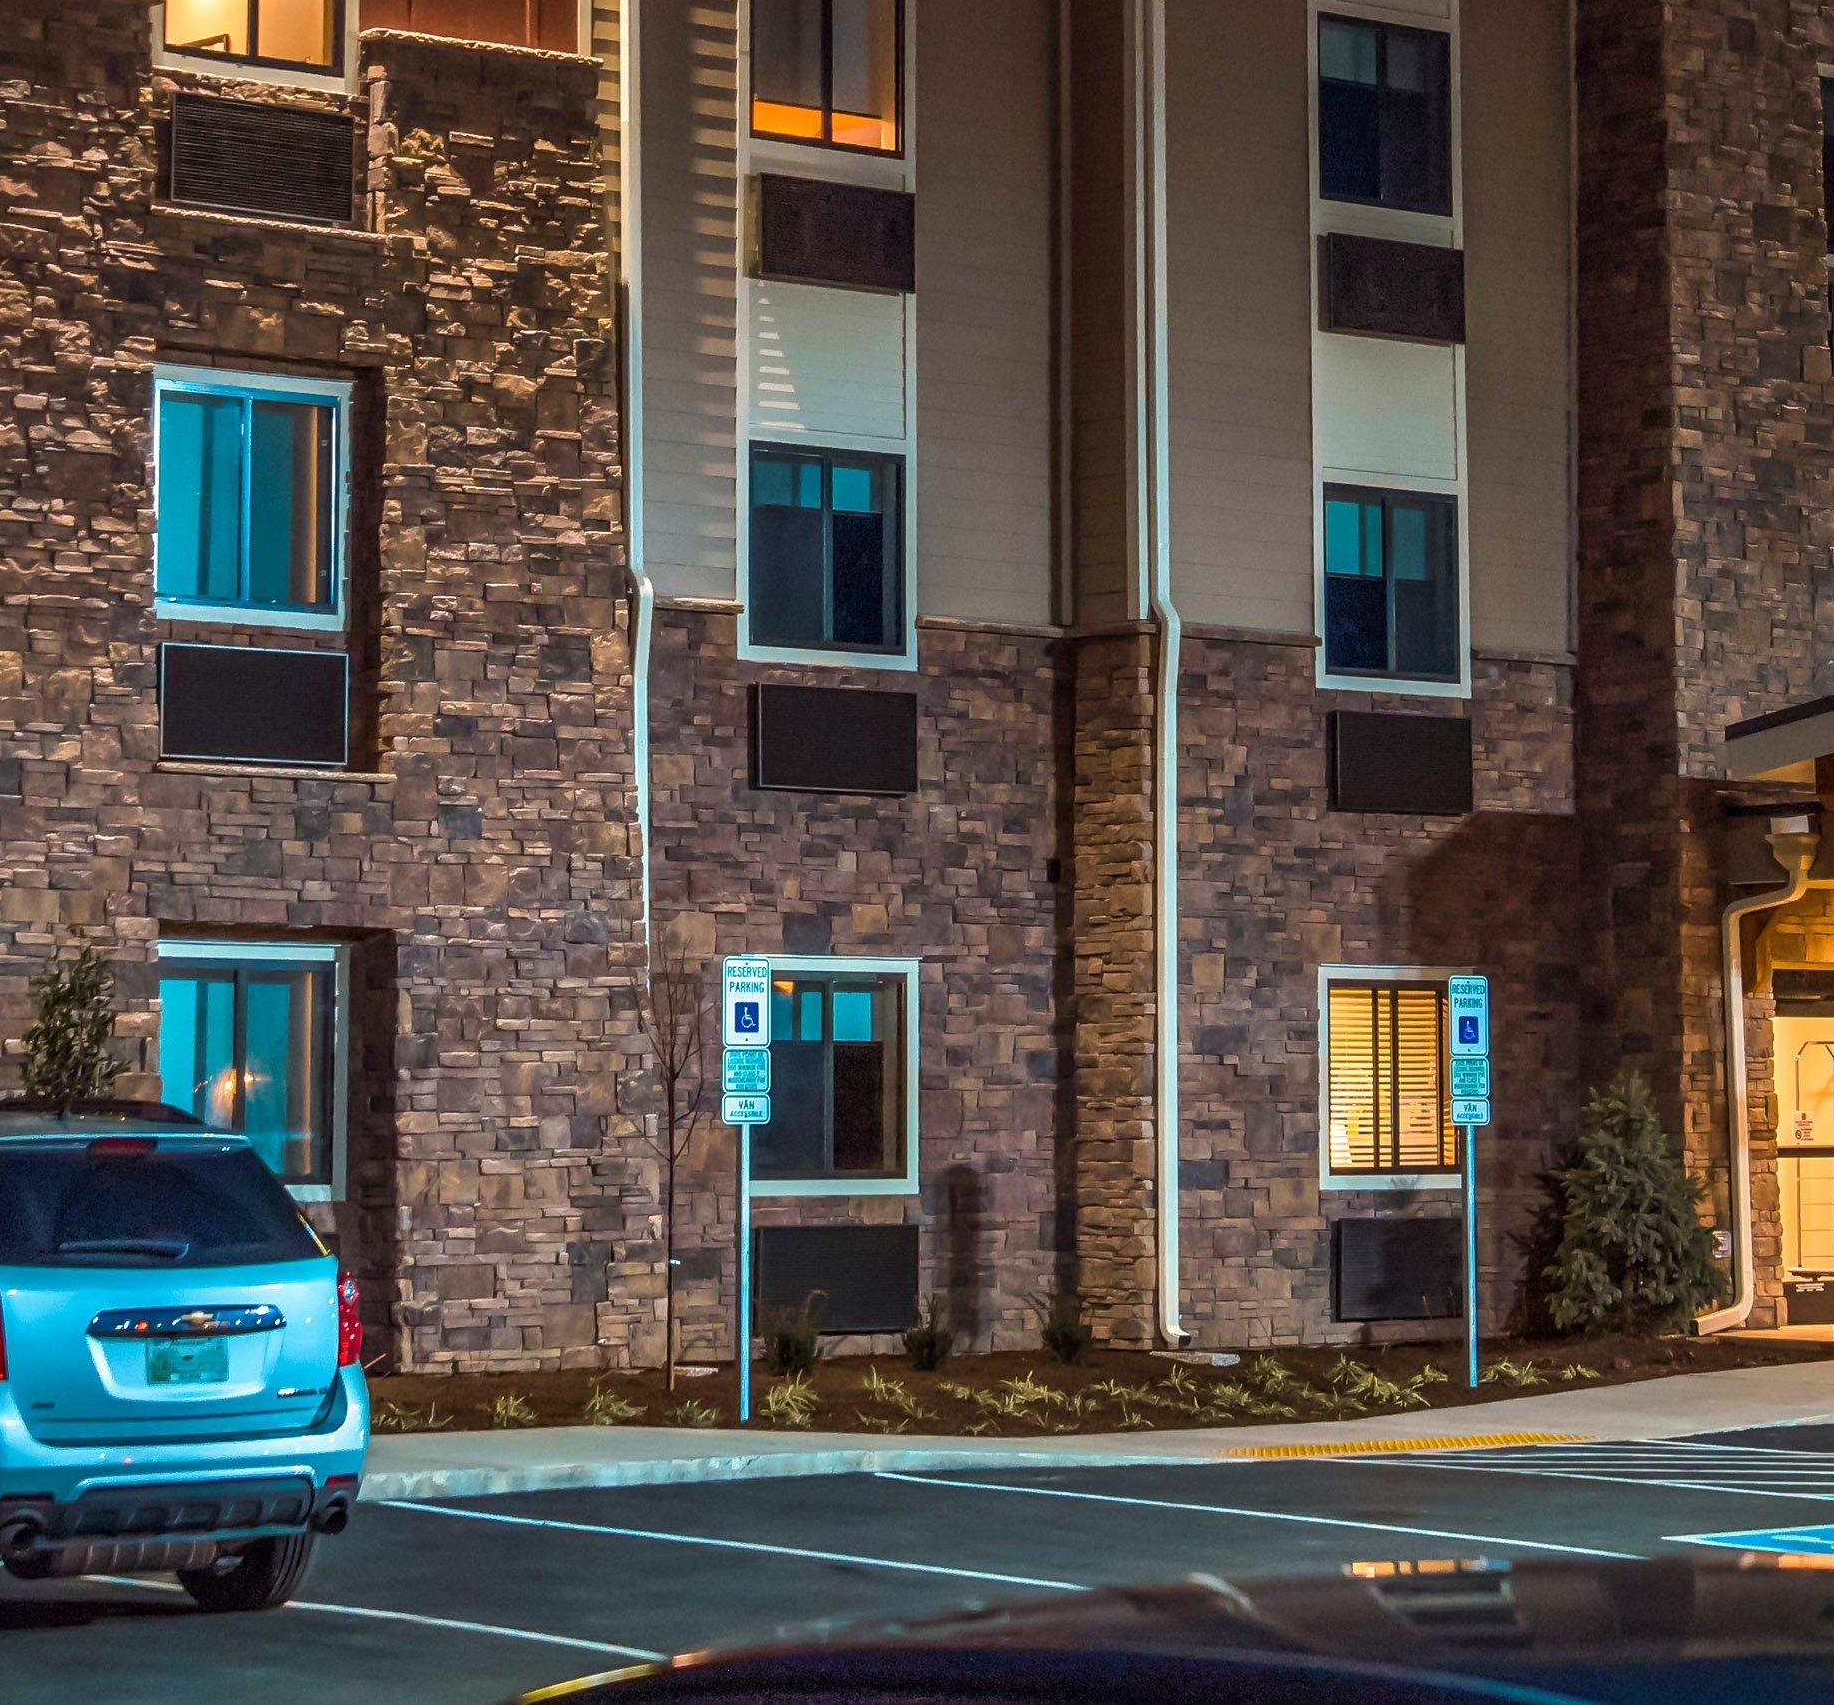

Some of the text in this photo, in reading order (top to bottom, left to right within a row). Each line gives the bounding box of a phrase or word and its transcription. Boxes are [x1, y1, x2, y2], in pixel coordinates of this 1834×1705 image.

[727, 966, 767, 977] RESERVED
[729, 981, 765, 993] PARKING
[1452, 983, 1486, 994] RESERVED
[1454, 998, 1482, 1008] PARKING
[739, 1101, 755, 1109] VAN
[1463, 1104, 1477, 1112] VAN
